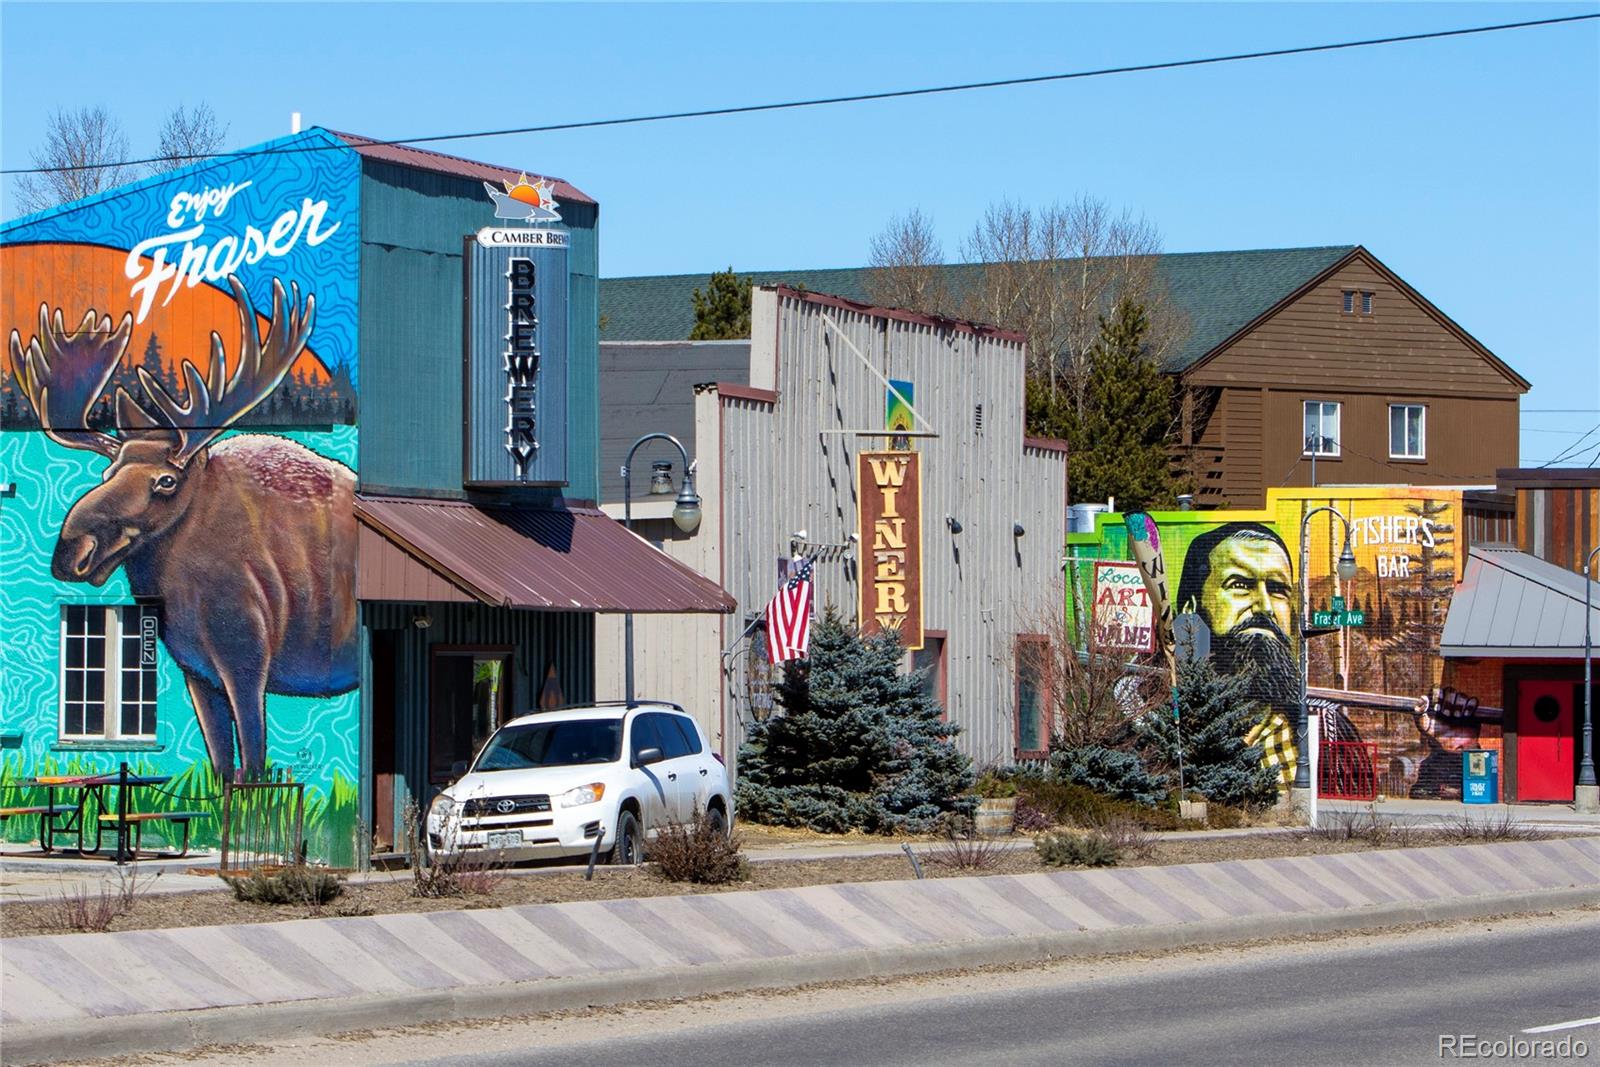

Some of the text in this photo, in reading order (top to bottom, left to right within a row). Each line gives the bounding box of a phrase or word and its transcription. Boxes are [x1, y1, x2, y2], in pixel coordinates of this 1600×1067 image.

[167, 180, 253, 228] Enjoy
[491, 231, 544, 244] CAMBER
[124, 198, 342, 324] Fraser
[504, 257, 541, 485] BREWERY
[1351, 515, 1435, 549] FISHER'S
[1098, 568, 1144, 585] Loca
[1377, 555, 1410, 578] BAR
[1097, 587, 1150, 607] ART
[1314, 612, 1363, 625] Fraser Ave
[143, 619, 155, 662] OPEN
